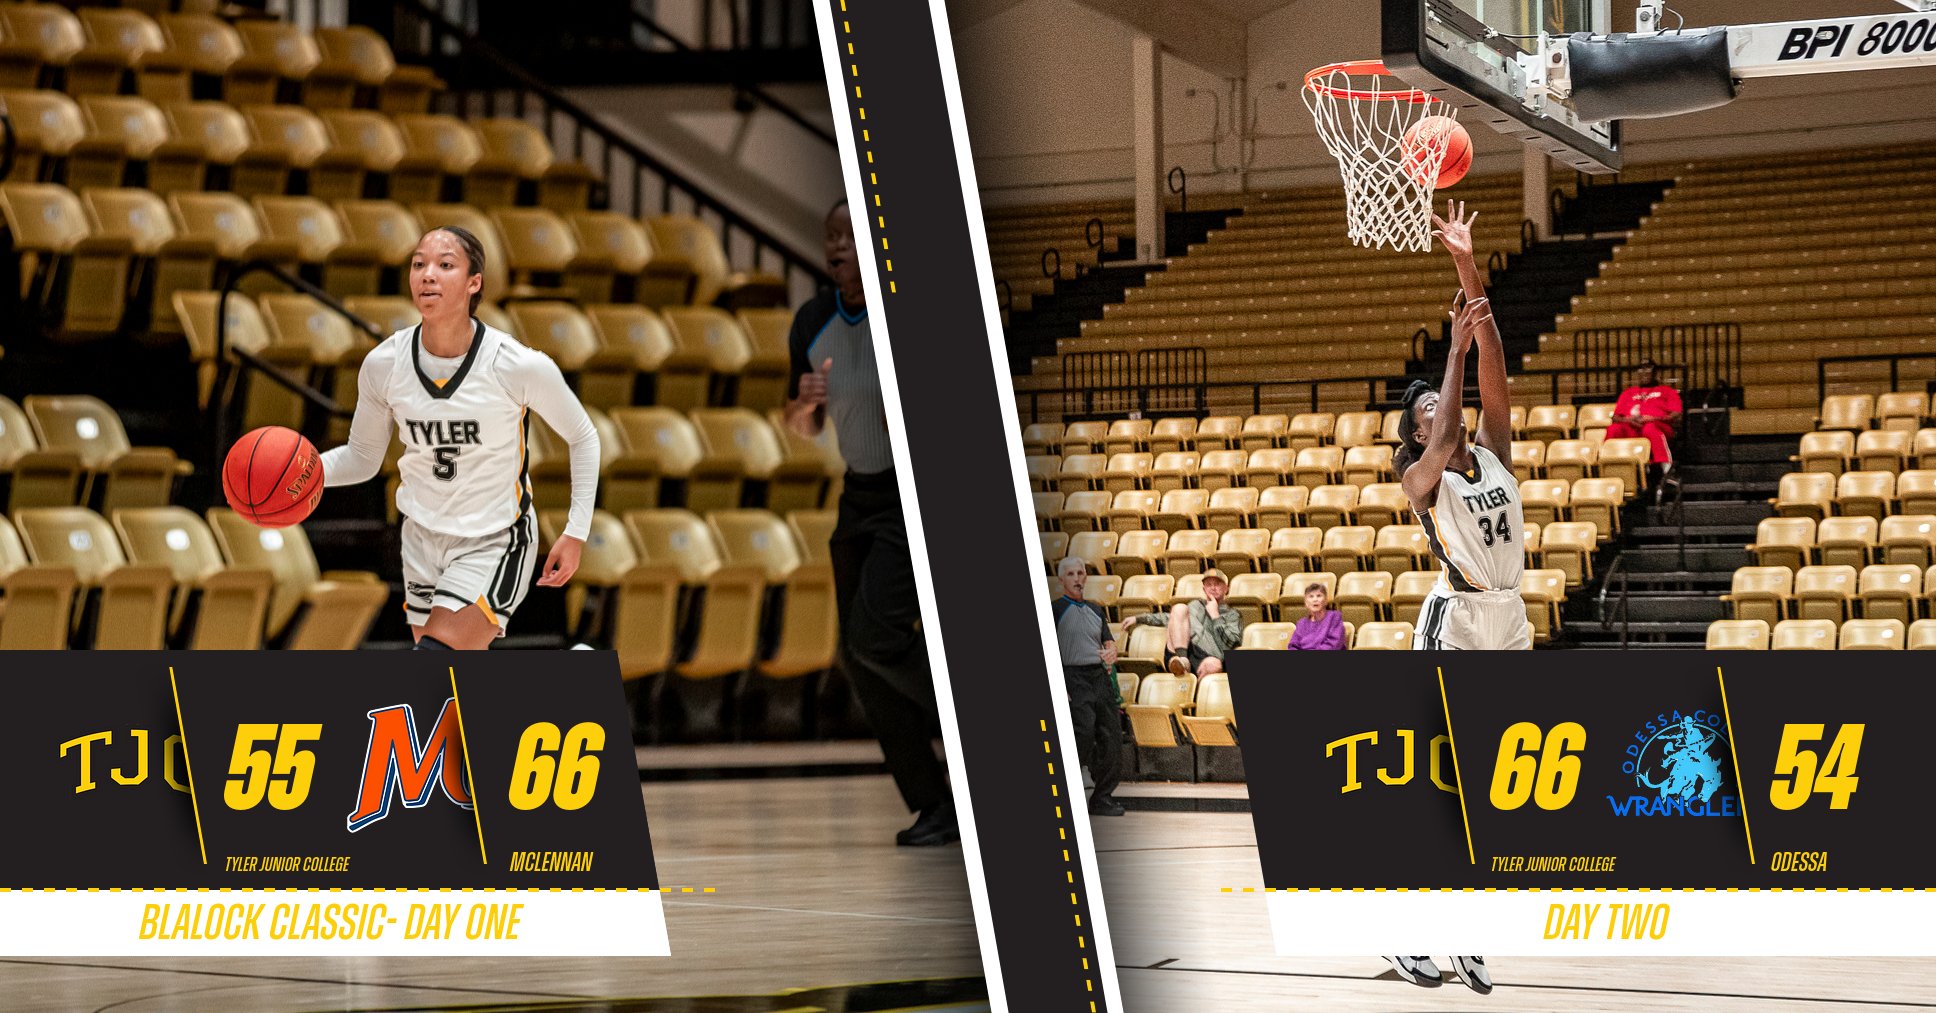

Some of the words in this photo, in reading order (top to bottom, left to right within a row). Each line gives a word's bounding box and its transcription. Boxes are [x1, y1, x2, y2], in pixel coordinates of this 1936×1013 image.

[1777, 24, 1855, 61] BPI
[405, 418, 482, 445] TYLER
[432, 446, 460, 482] 5
[1462, 486, 1512, 514] TYLER
[1478, 510, 1513, 548] 34
